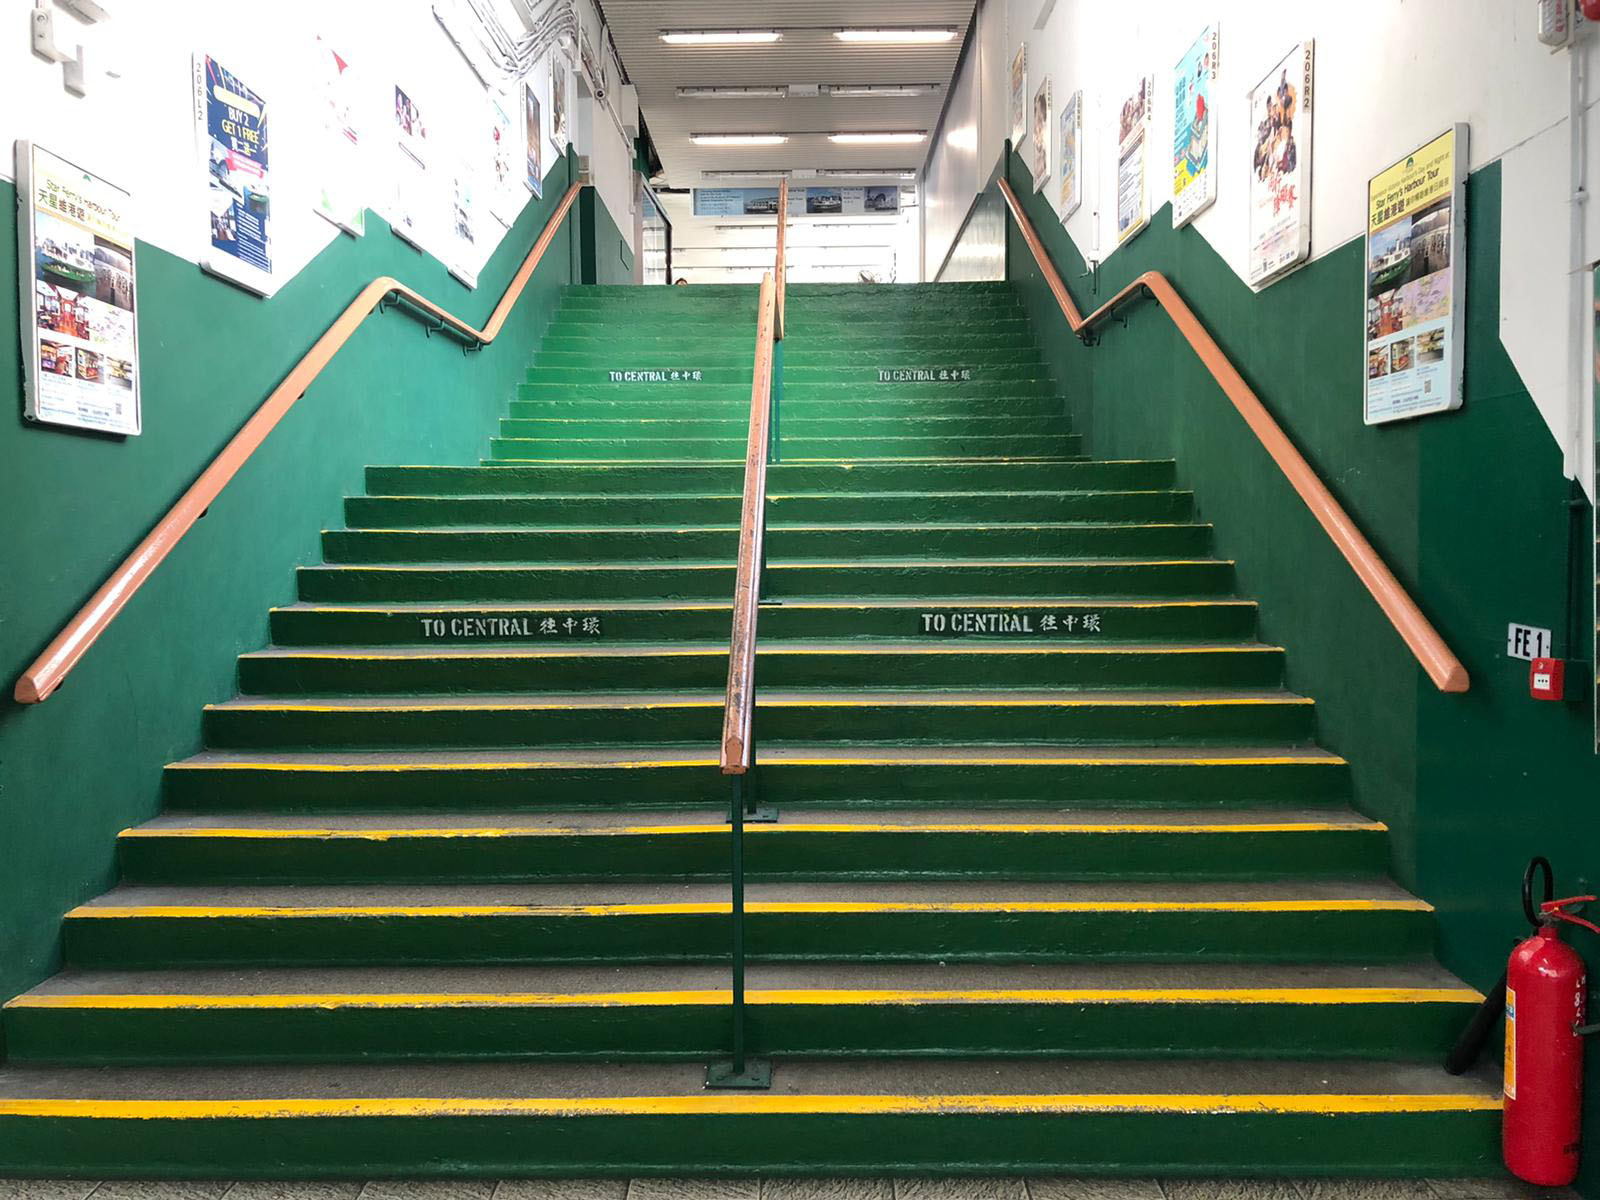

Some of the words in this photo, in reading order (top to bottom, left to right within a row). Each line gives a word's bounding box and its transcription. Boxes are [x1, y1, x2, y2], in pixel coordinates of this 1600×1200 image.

[1303, 49, 1311, 108] 206R2
[228, 106, 243, 124] BUY
[243, 112, 250, 127] 2
[222, 119, 236, 136] GET
[242, 126, 260, 144] FREE
[1376, 197, 1386, 210] Star
[1387, 187, 1404, 203] Ferry's
[1404, 175, 1426, 193] Harbour
[1427, 167, 1440, 180] Tour
[609, 371, 622, 382] TO
[624, 371, 667, 382] CENTRAL
[879, 370, 890, 381] TO
[893, 370, 935, 381] CENTRAL
[421, 618, 446, 637] TO
[451, 618, 533, 636] CENTRAL
[921, 613, 946, 632] TO
[951, 613, 1033, 632] CENTRAL
[1515, 627, 1531, 657] FE
[1537, 631, 1542, 658] 1
